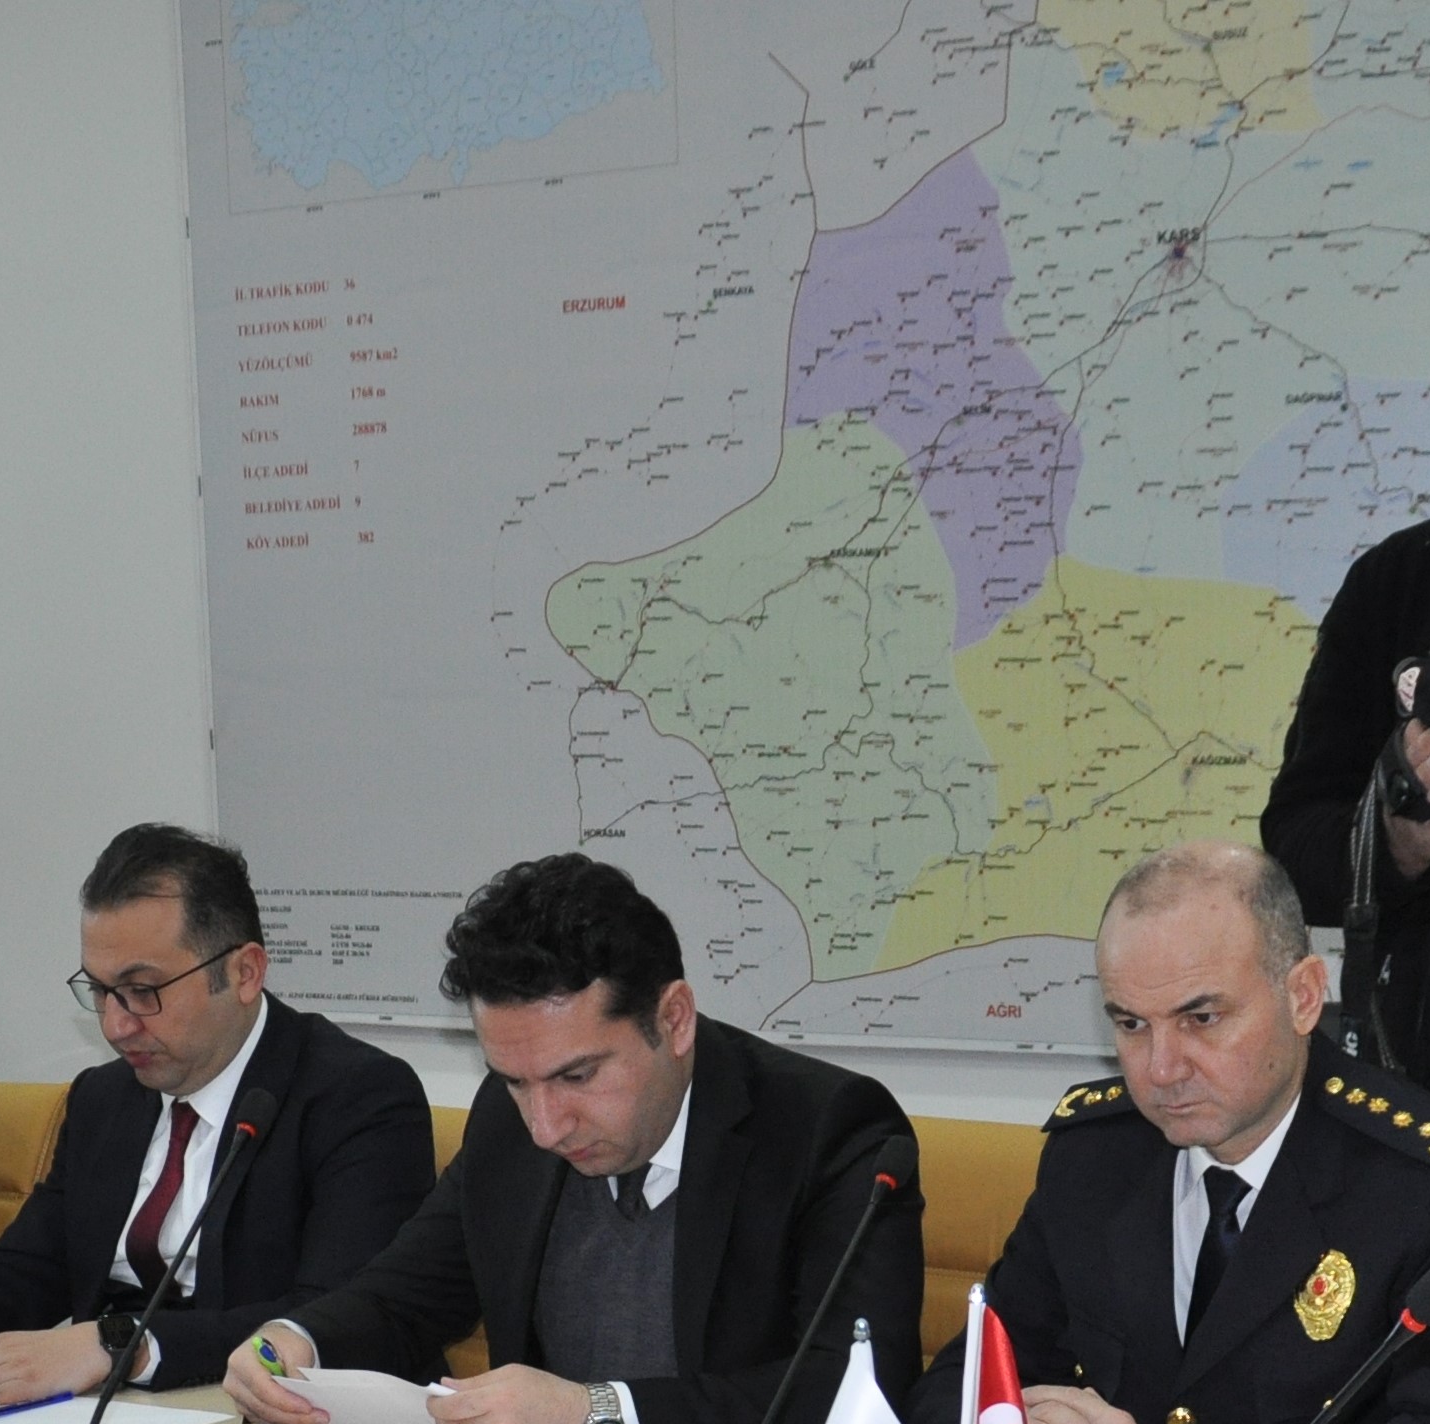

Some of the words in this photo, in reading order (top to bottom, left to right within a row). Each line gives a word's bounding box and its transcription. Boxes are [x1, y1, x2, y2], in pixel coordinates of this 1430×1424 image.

[1157, 226, 1201, 245] KARS
[250, 283, 292, 299] TRAFİK
[295, 280, 330, 295] KODU
[562, 295, 626, 314] ERZURUM
[238, 321, 290, 337] TELEFON
[293, 316, 327, 332] KODU
[239, 352, 313, 373] YÜZÖLÇÜMÜ
[240, 394, 279, 408] RAKIM
[241, 429, 279, 444] NÜFUS
[243, 464, 270, 481] İLÇE
[273, 459, 308, 477] ADEDİ
[245, 497, 303, 515] BELEDİYE
[305, 494, 341, 511] ADEDİ
[246, 533, 270, 549] KÖY
[273, 532, 309, 548] ADEDİ
[583, 827, 626, 839] HORASAN
[986, 1002, 1022, 1018] AĞRI
